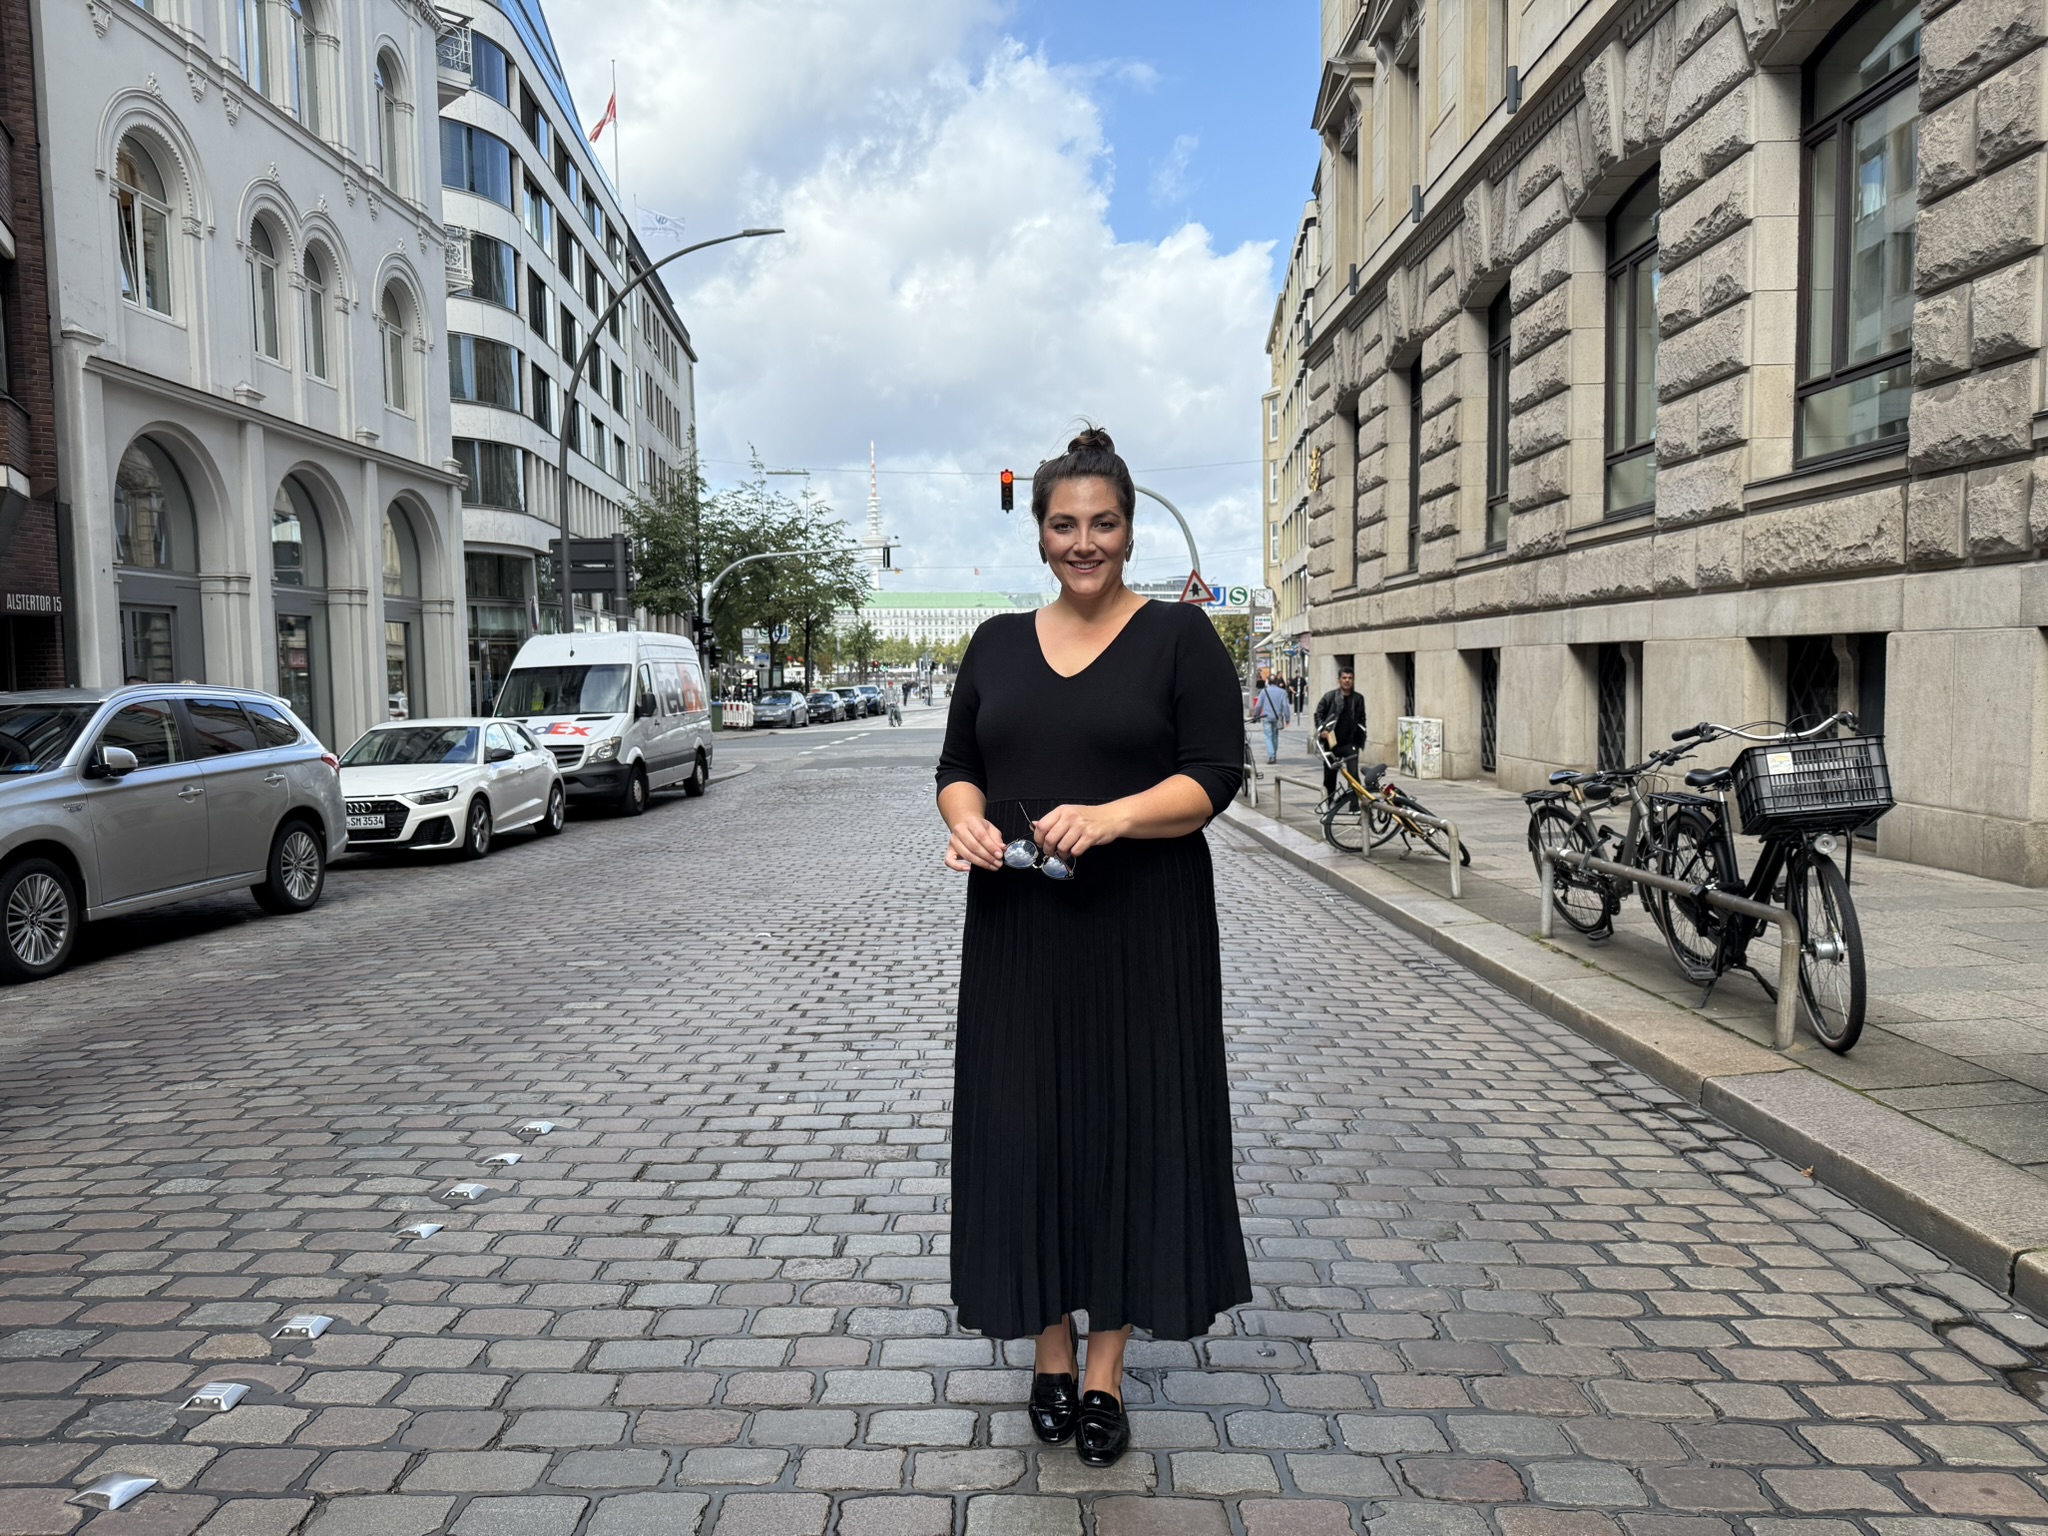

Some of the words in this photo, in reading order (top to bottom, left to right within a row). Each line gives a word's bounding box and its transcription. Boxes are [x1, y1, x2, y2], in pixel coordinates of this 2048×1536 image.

[6, 593, 51, 612] ALSTERTOR
[53, 596, 62, 612] 15
[1230, 588, 1247, 604] S
[527, 722, 593, 737] dEx
[350, 817, 361, 827] SM
[363, 816, 383, 826] 3534
